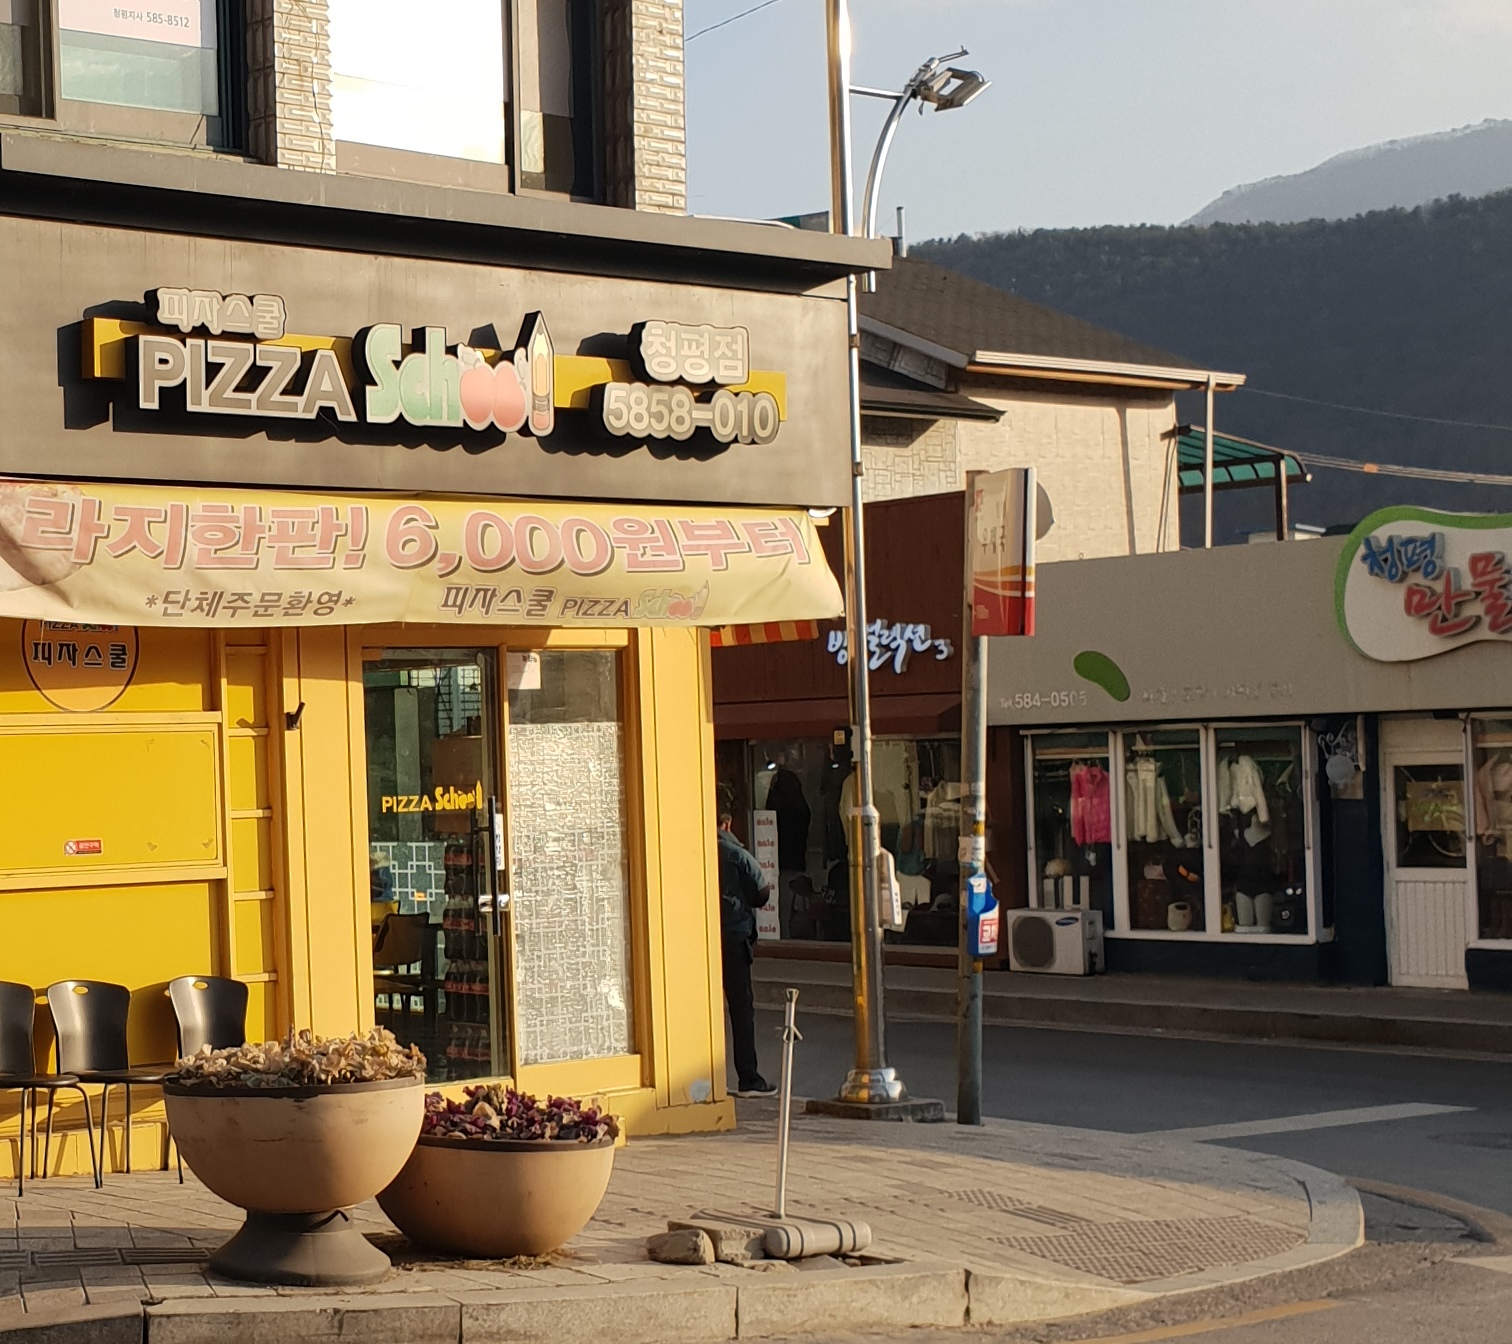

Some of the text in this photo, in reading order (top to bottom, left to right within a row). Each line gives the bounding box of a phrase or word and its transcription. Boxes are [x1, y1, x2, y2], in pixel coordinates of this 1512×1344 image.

[113, 8, 190, 28] 청평지사 585-8512
[157, 287, 286, 339] 피자스쿨
[138, 334, 359, 422] PIZZA
[643, 323, 748, 382] 청평점
[605, 385, 778, 442] 5858-010
[19, 495, 811, 577] 라지한판! 6,000원부터
[1361, 532, 1440, 583] 청평
[438, 584, 556, 619] 피자스쿨
[558, 596, 632, 620] PIZZA
[32, 641, 128, 671] 피자스쿨
[381, 794, 433, 814] PIZZA
